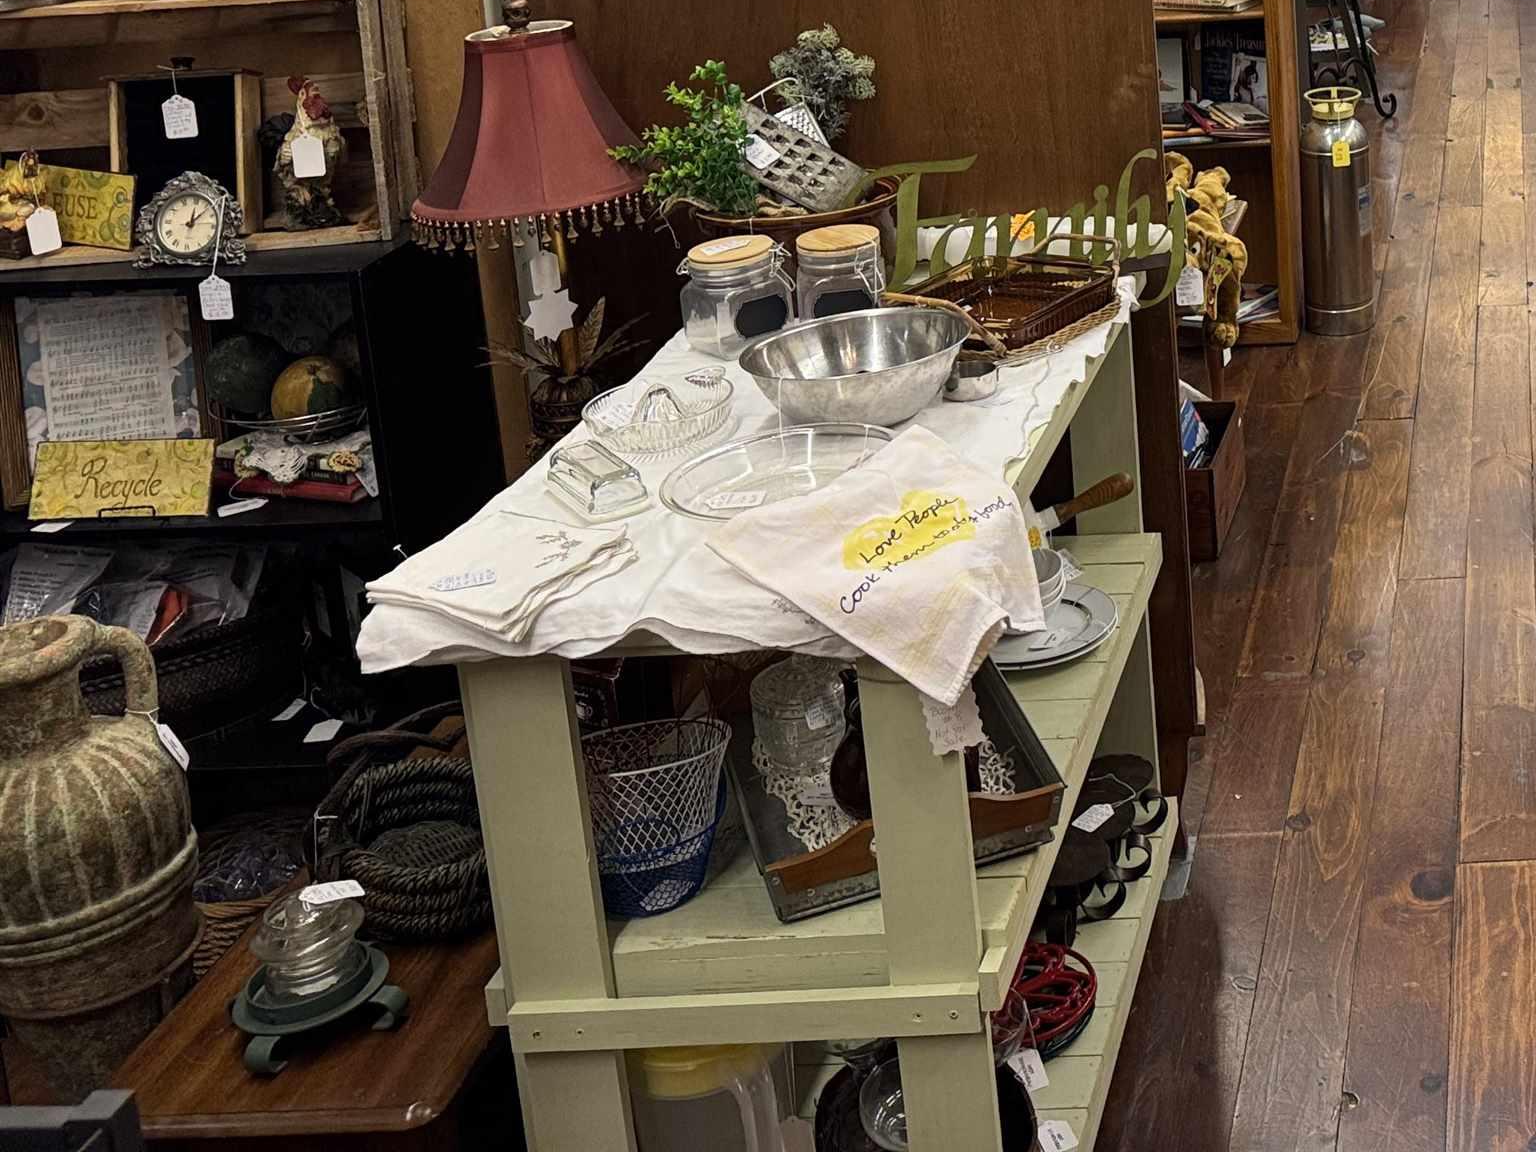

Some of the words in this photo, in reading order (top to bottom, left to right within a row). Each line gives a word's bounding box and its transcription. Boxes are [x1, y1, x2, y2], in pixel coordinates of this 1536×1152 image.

[51, 192, 98, 219] EUSE
[848, 148, 1187, 309] Family
[74, 456, 162, 510] Recycle
[860, 529, 902, 564] Love
[895, 497, 960, 529] People
[840, 573, 880, 614] Cook
